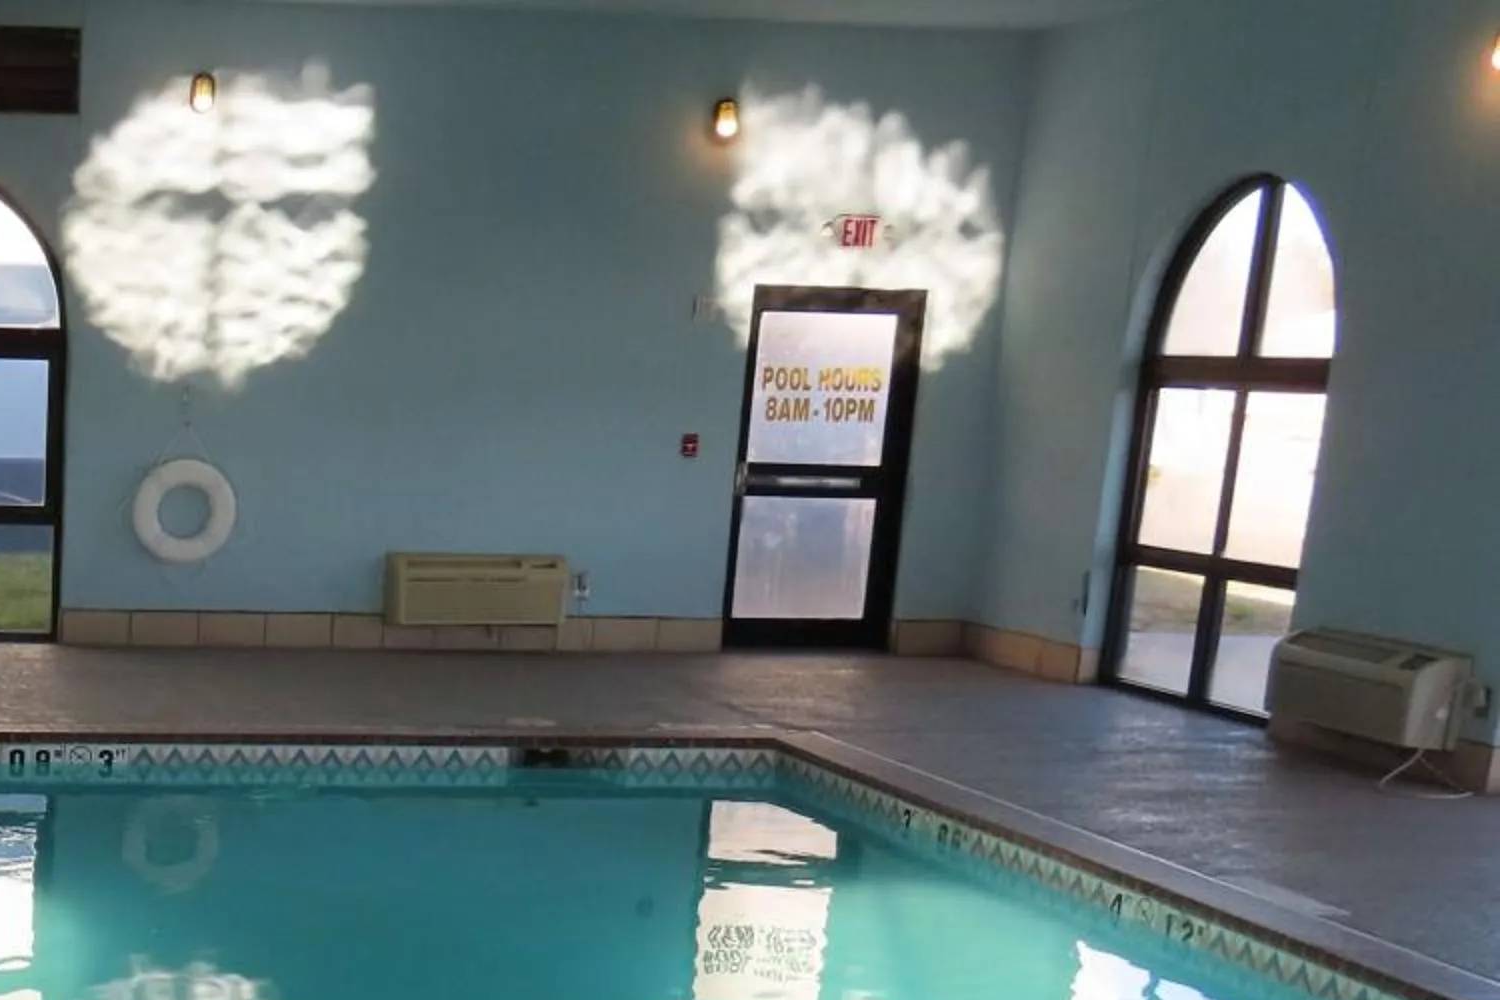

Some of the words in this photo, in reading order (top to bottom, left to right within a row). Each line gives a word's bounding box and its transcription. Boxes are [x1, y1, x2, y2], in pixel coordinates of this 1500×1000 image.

[841, 219, 878, 248] EXIT
[762, 367, 812, 391] POOL
[818, 367, 882, 392] HOURS
